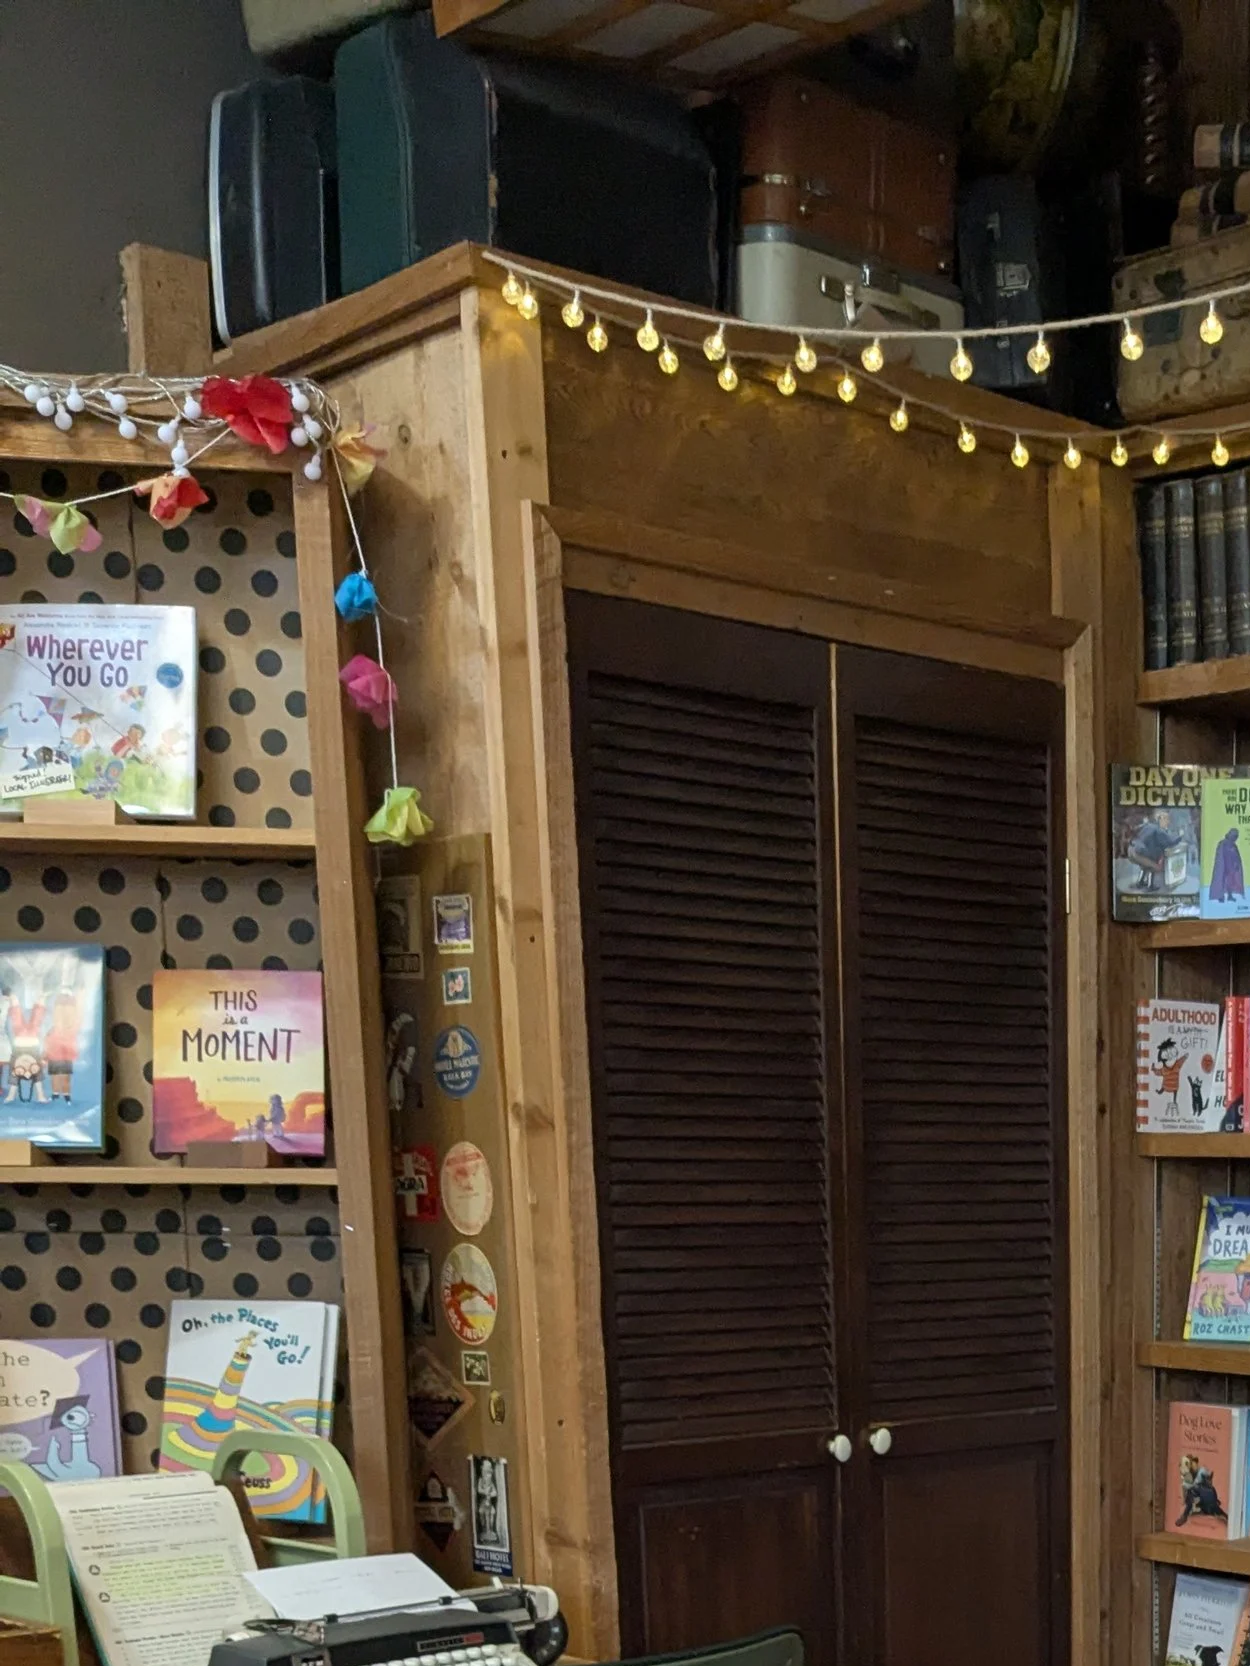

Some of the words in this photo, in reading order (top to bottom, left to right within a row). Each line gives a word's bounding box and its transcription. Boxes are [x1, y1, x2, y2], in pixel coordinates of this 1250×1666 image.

[26, 634, 148, 661] Wherever
[47, 662, 91, 687] YOU
[100, 662, 129, 688] GO
[1129, 767, 1178, 786] DAY
[1182, 767, 1234, 786] ONE
[1225, 804, 1248, 814] WAY
[209, 989, 258, 1012] THIS
[222, 1014, 237, 1027] is
[240, 1016, 249, 1026] a
[1152, 1008, 1217, 1025] ADULTHOOD
[181, 1027, 302, 1064] MOMENT
[181, 1318, 209, 1333] Oh,
[210, 1312, 234, 1325] the
[237, 1307, 279, 1333] Places
[1192, 1323, 1213, 1335] ROZ
[1217, 1323, 1250, 1335] CHAST
[263, 1333, 299, 1350] You'll
[276, 1346, 311, 1365] Go!
[1199, 1417, 1222, 1430] Love
[1184, 1431, 1216, 1445] Stories
